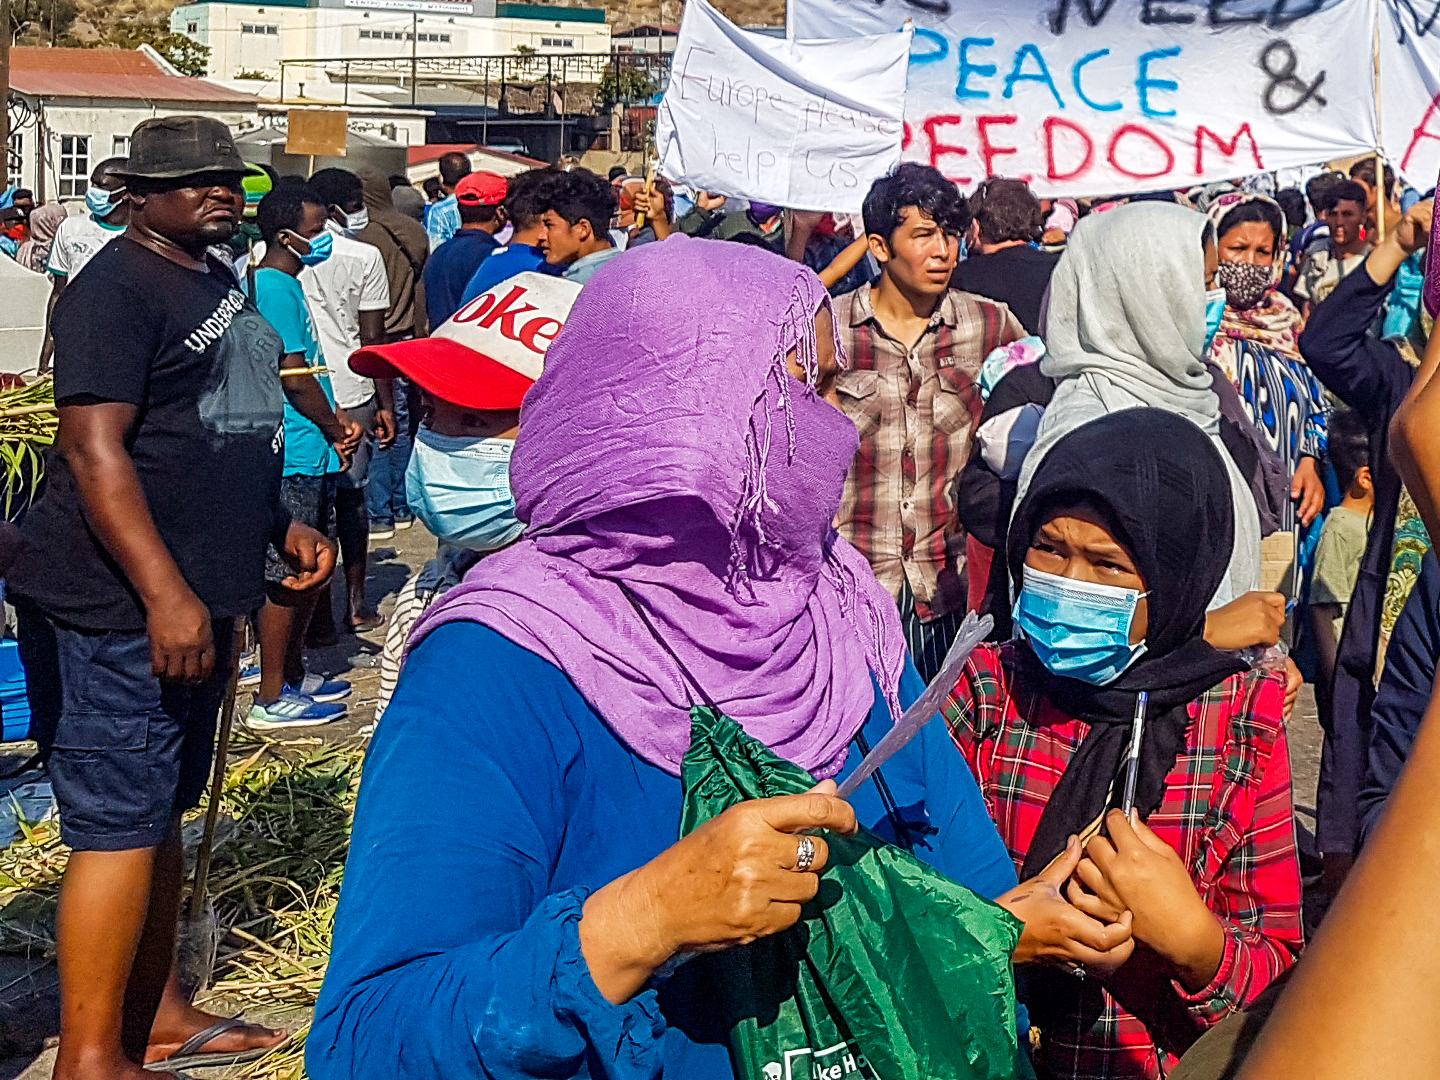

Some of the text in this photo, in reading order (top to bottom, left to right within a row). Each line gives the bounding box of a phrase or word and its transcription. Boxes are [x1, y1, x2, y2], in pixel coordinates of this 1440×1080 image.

[680, 46, 784, 125] Europe
[898, 25, 1328, 118] PEACE &
[711, 123, 777, 185] help
